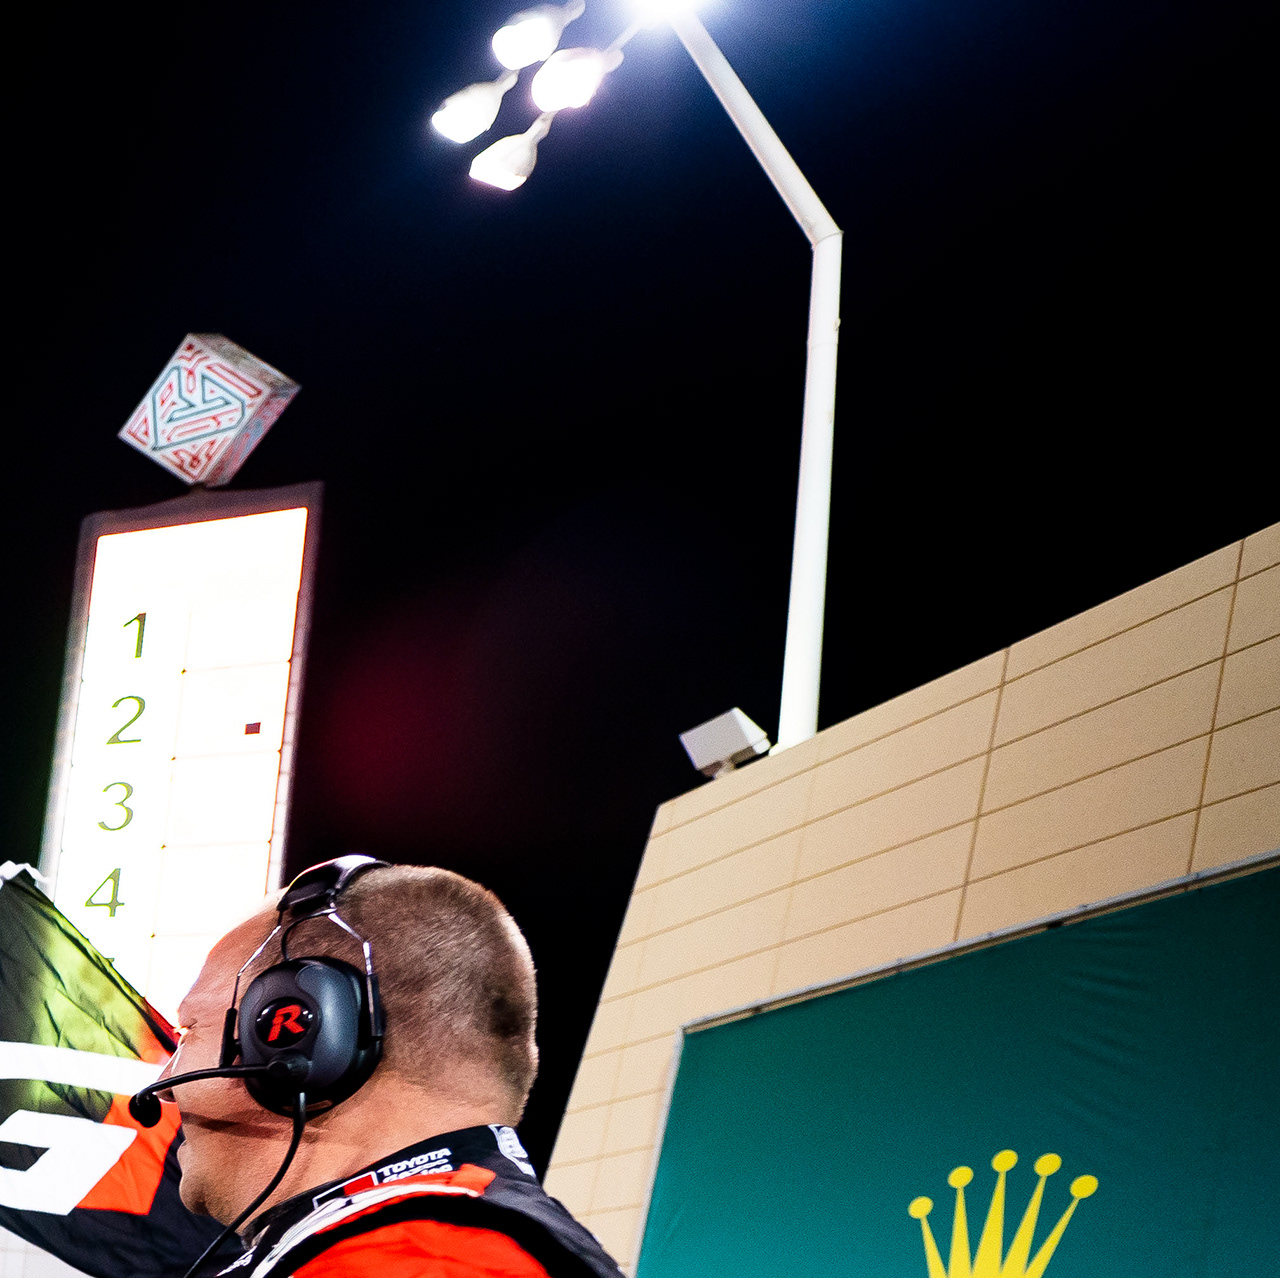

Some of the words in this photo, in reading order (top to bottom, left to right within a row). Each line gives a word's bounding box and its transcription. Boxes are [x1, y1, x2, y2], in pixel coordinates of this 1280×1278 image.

[123, 612, 146, 659] 1
[106, 695, 147, 745] 2
[97, 781, 134, 832] 3
[84, 868, 126, 918] 4
[376, 1147, 453, 1177] TOYOTA
